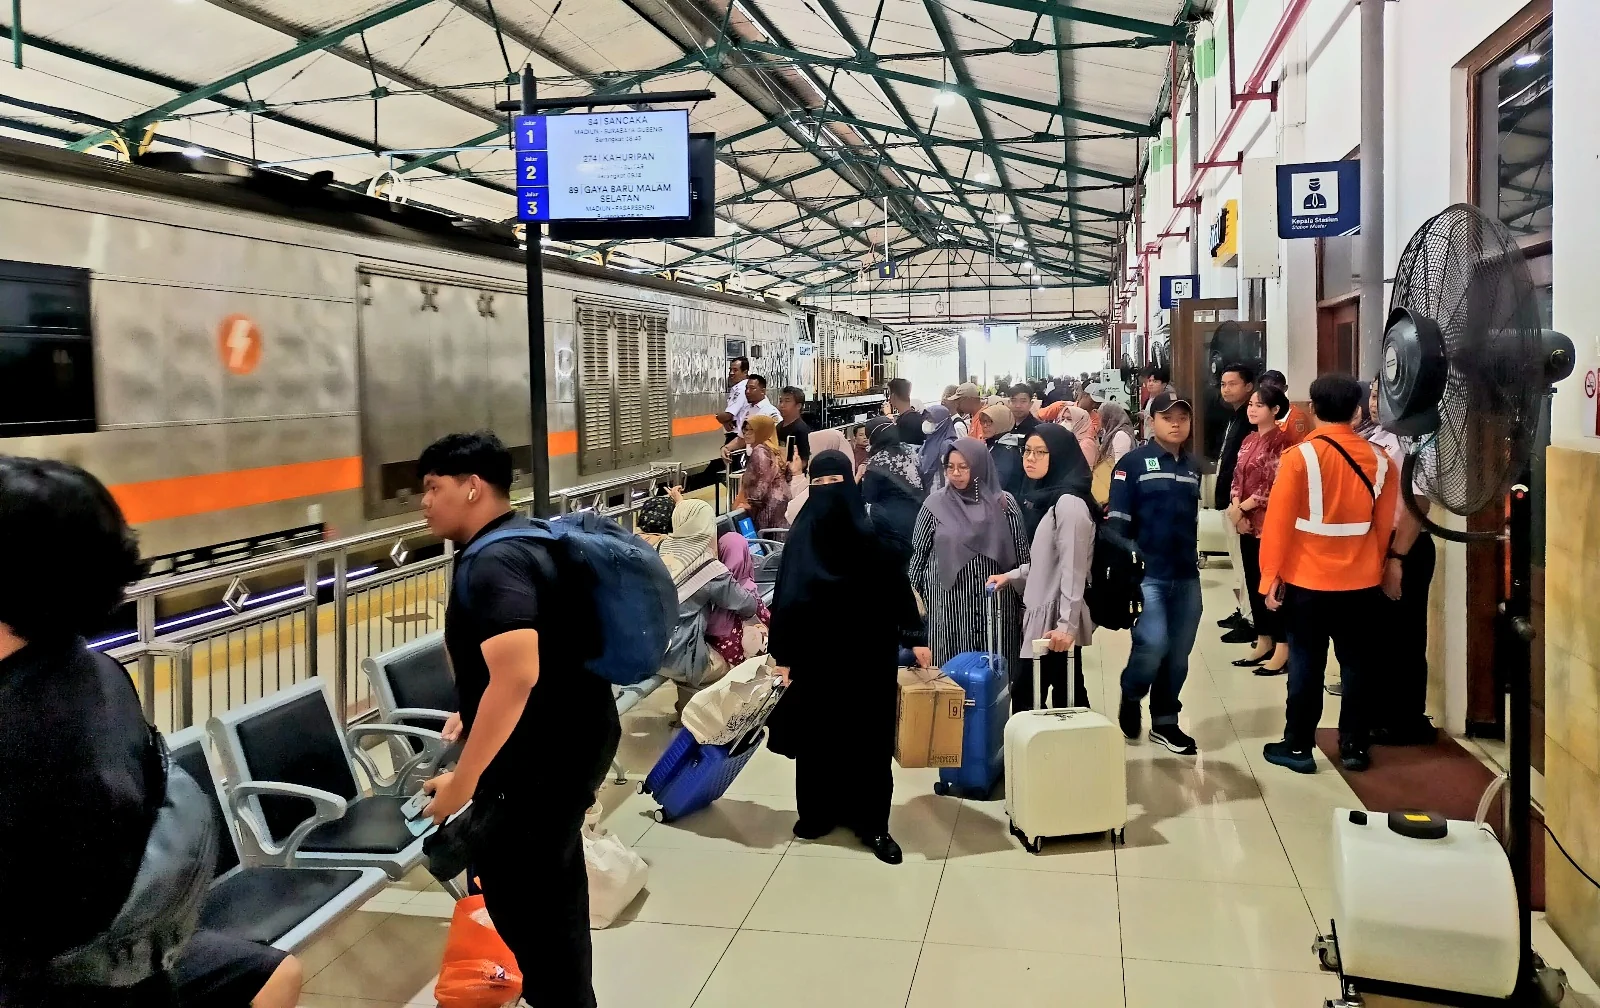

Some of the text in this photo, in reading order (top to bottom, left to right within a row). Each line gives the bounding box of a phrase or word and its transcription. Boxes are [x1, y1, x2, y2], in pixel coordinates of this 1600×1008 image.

[603, 116, 648, 125] SANCAKA
[526, 129, 534, 144] 1
[603, 153, 655, 161] KAHURIPAN
[526, 165, 537, 180] 2
[568, 186, 579, 194] 89
[584, 185, 608, 194] GAYA
[610, 185, 634, 193] BARU
[636, 183, 672, 192] MALAM
[600, 194, 640, 203] SELATAN
[527, 201, 538, 215] 3
[884, 265, 889, 275] 1
